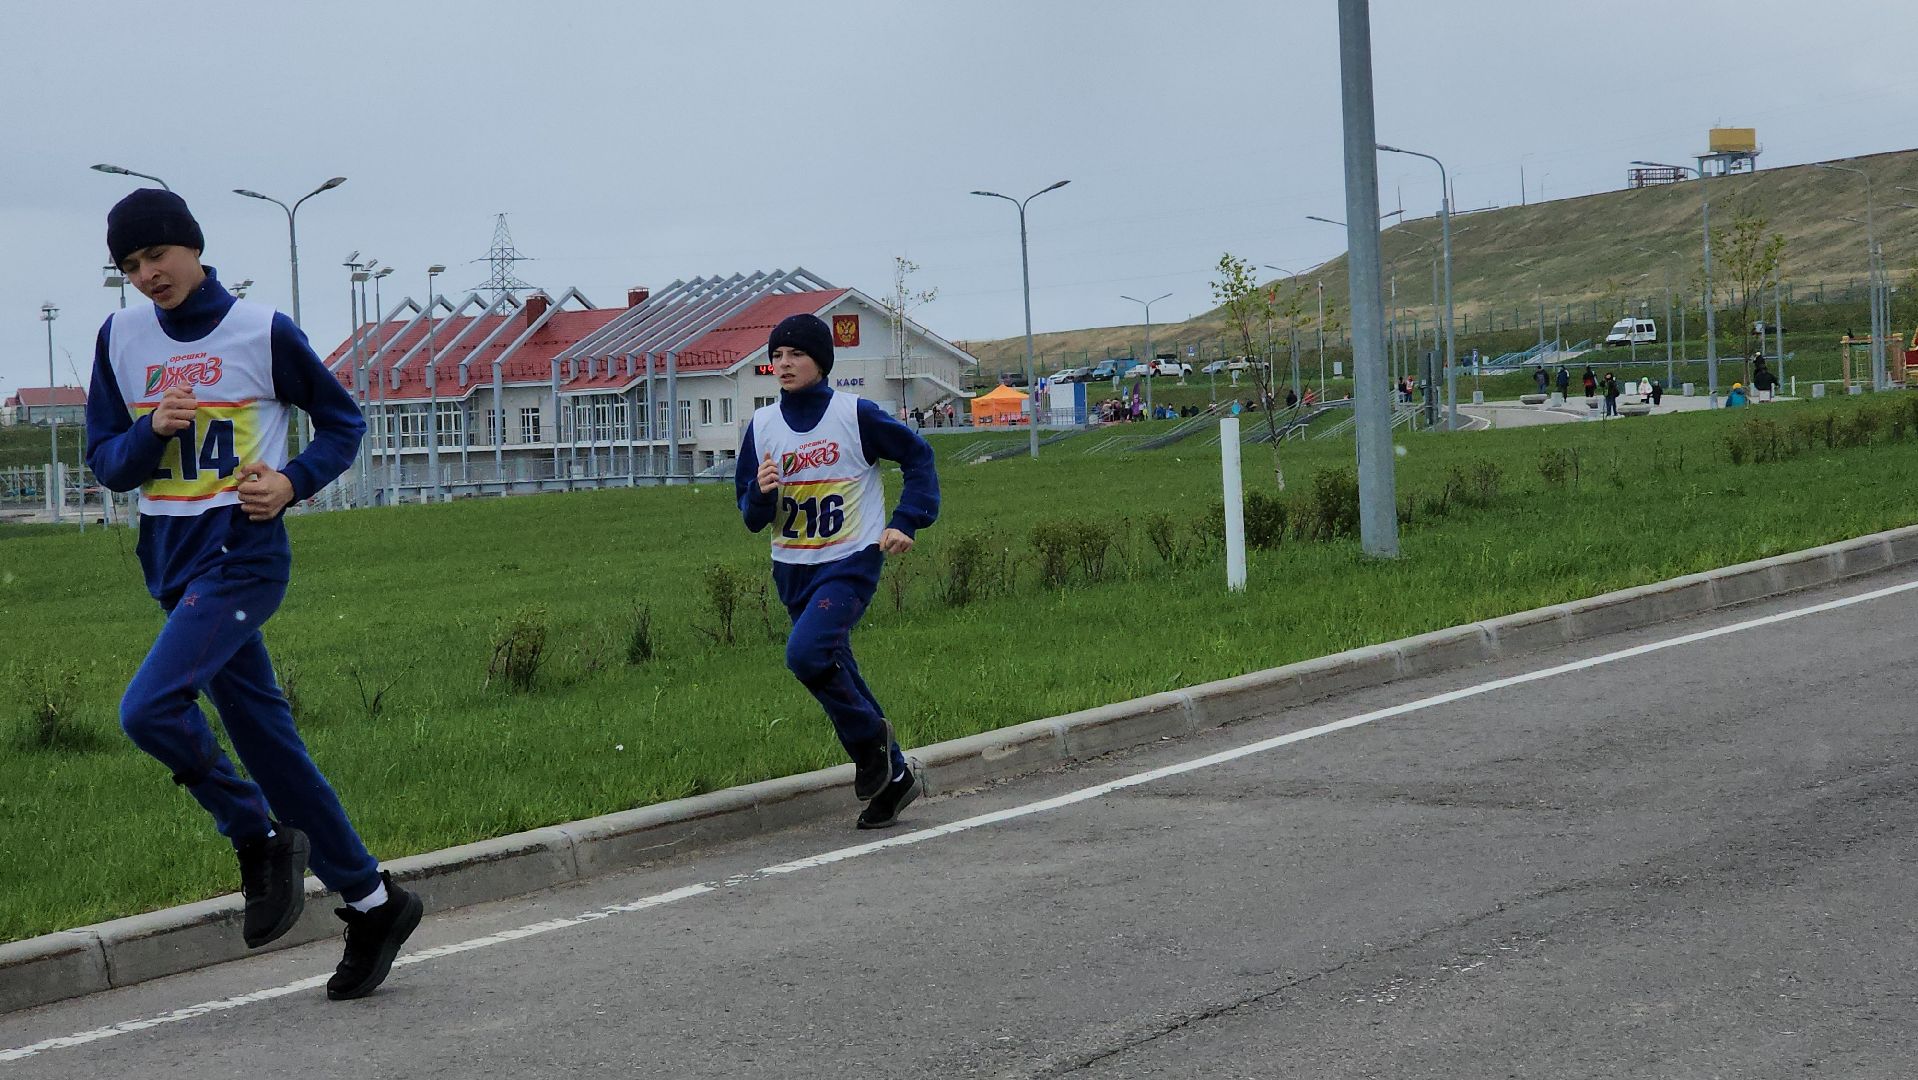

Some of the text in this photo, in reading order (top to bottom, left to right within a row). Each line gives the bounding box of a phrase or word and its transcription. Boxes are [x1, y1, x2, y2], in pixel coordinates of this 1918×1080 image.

[169, 352, 207, 363] орешки
[836, 377, 865, 387] КАФЕ
[152, 419, 240, 480] 14
[782, 442, 841, 477] Джаз
[782, 494, 845, 540] 216
